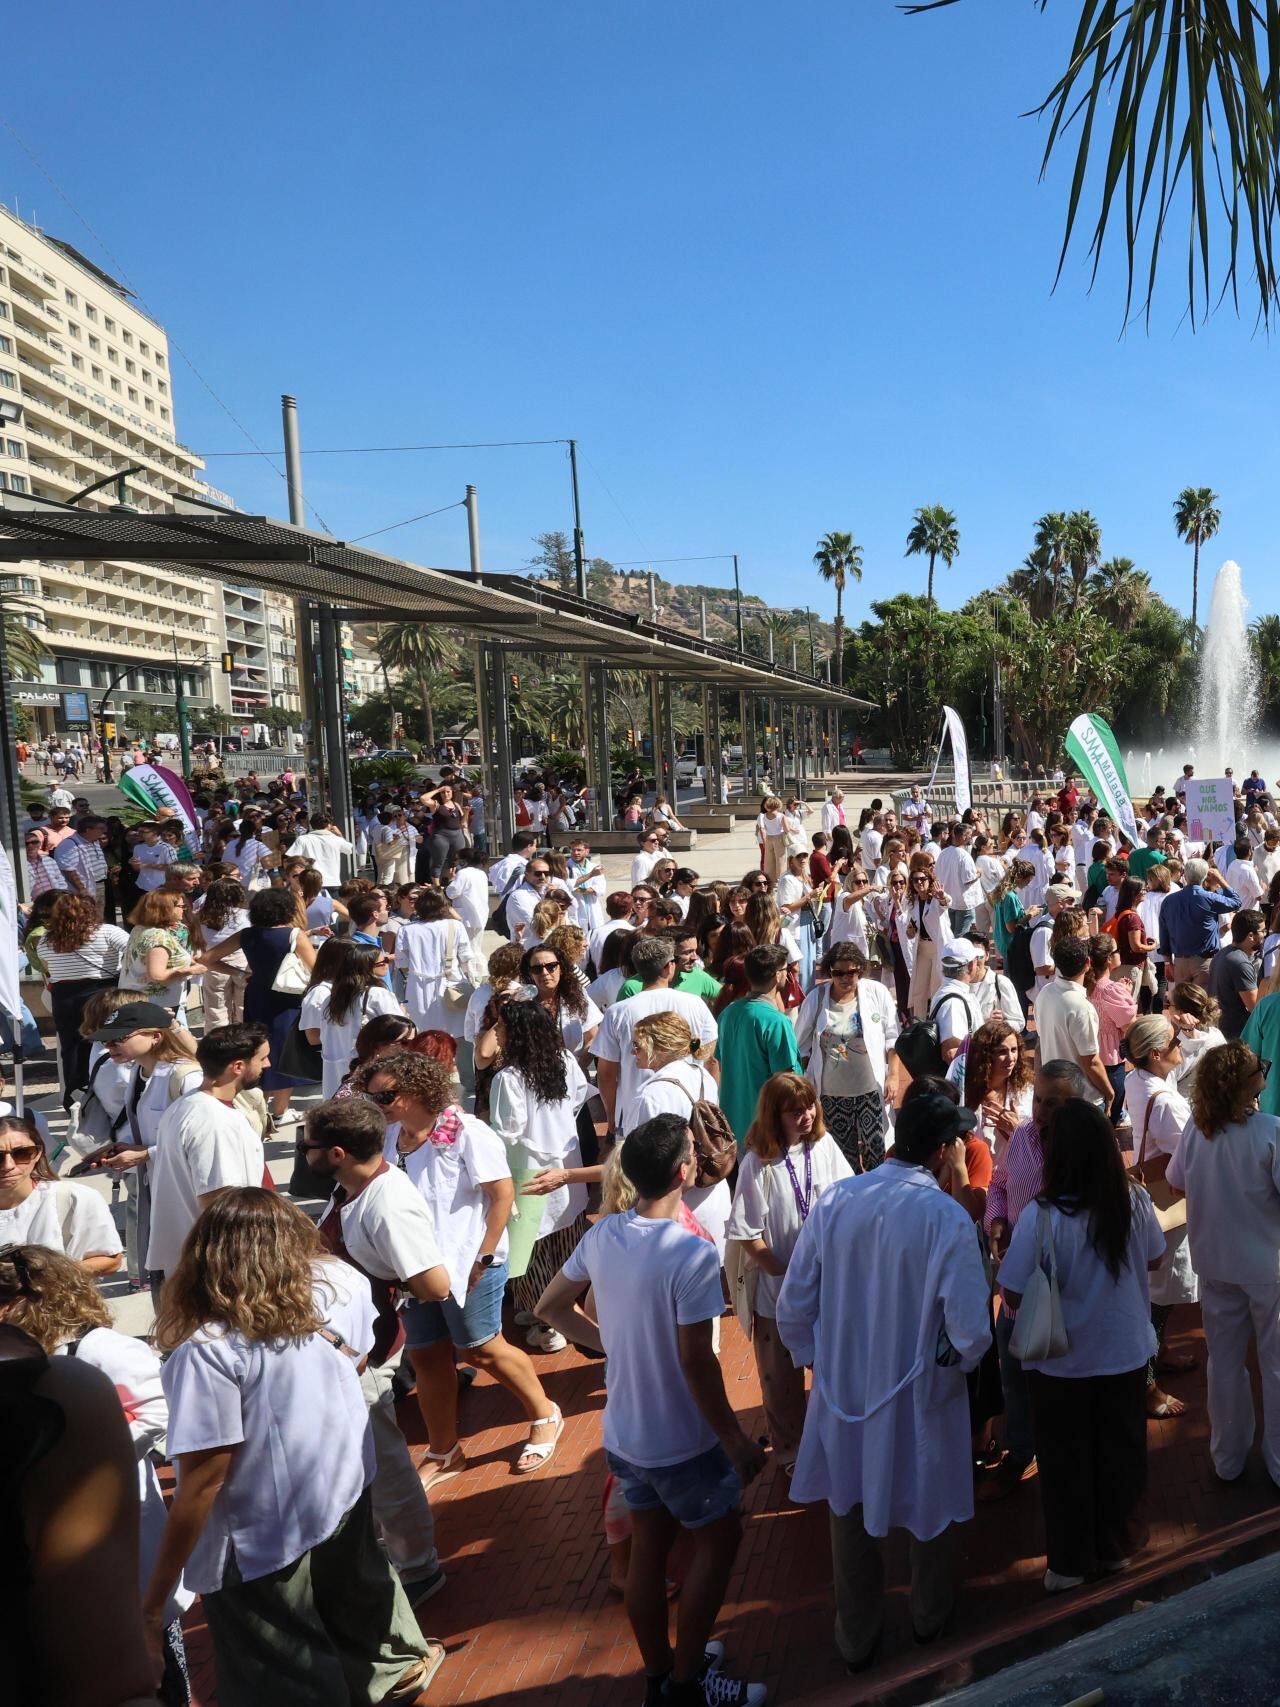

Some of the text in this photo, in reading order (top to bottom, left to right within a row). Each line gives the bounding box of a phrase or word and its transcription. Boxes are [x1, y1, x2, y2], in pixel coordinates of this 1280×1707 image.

[19, 691, 60, 701] PALACI
[1102, 759, 1127, 806] Málaga
[1200, 784, 1217, 793] QUE
[1198, 803, 1229, 812] VAMOS
